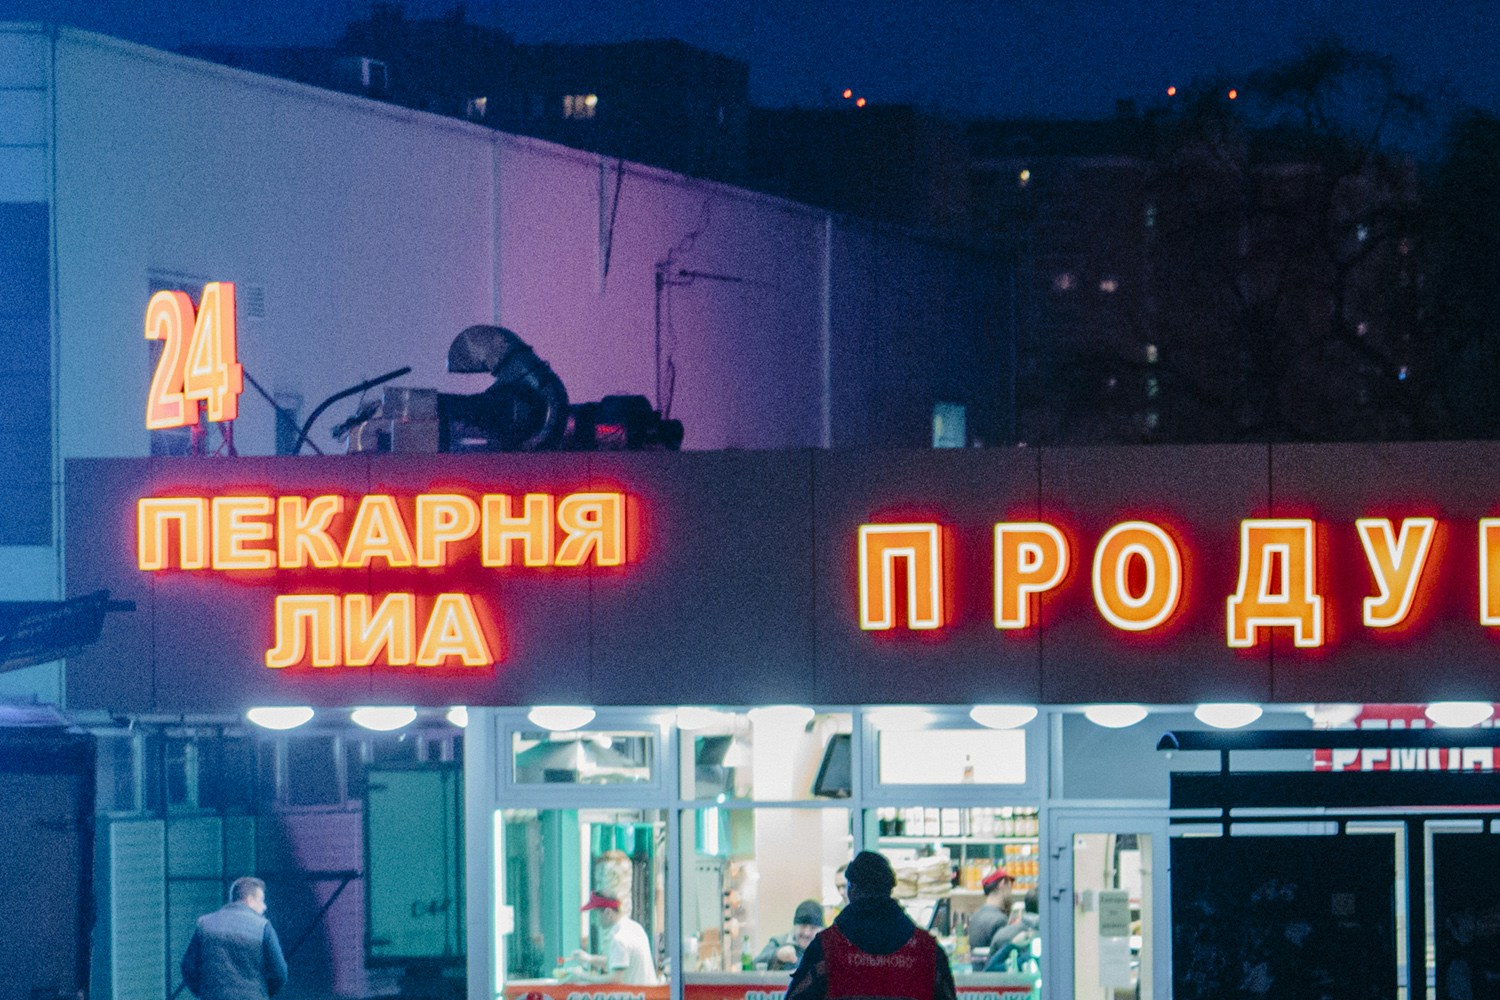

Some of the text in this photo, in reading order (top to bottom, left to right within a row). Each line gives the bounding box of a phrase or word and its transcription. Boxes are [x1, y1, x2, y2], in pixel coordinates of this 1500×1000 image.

[144, 281, 243, 430] 24
[138, 492, 631, 571] ПЕКАРНЯ
[265, 592, 494, 668] ЛИА
